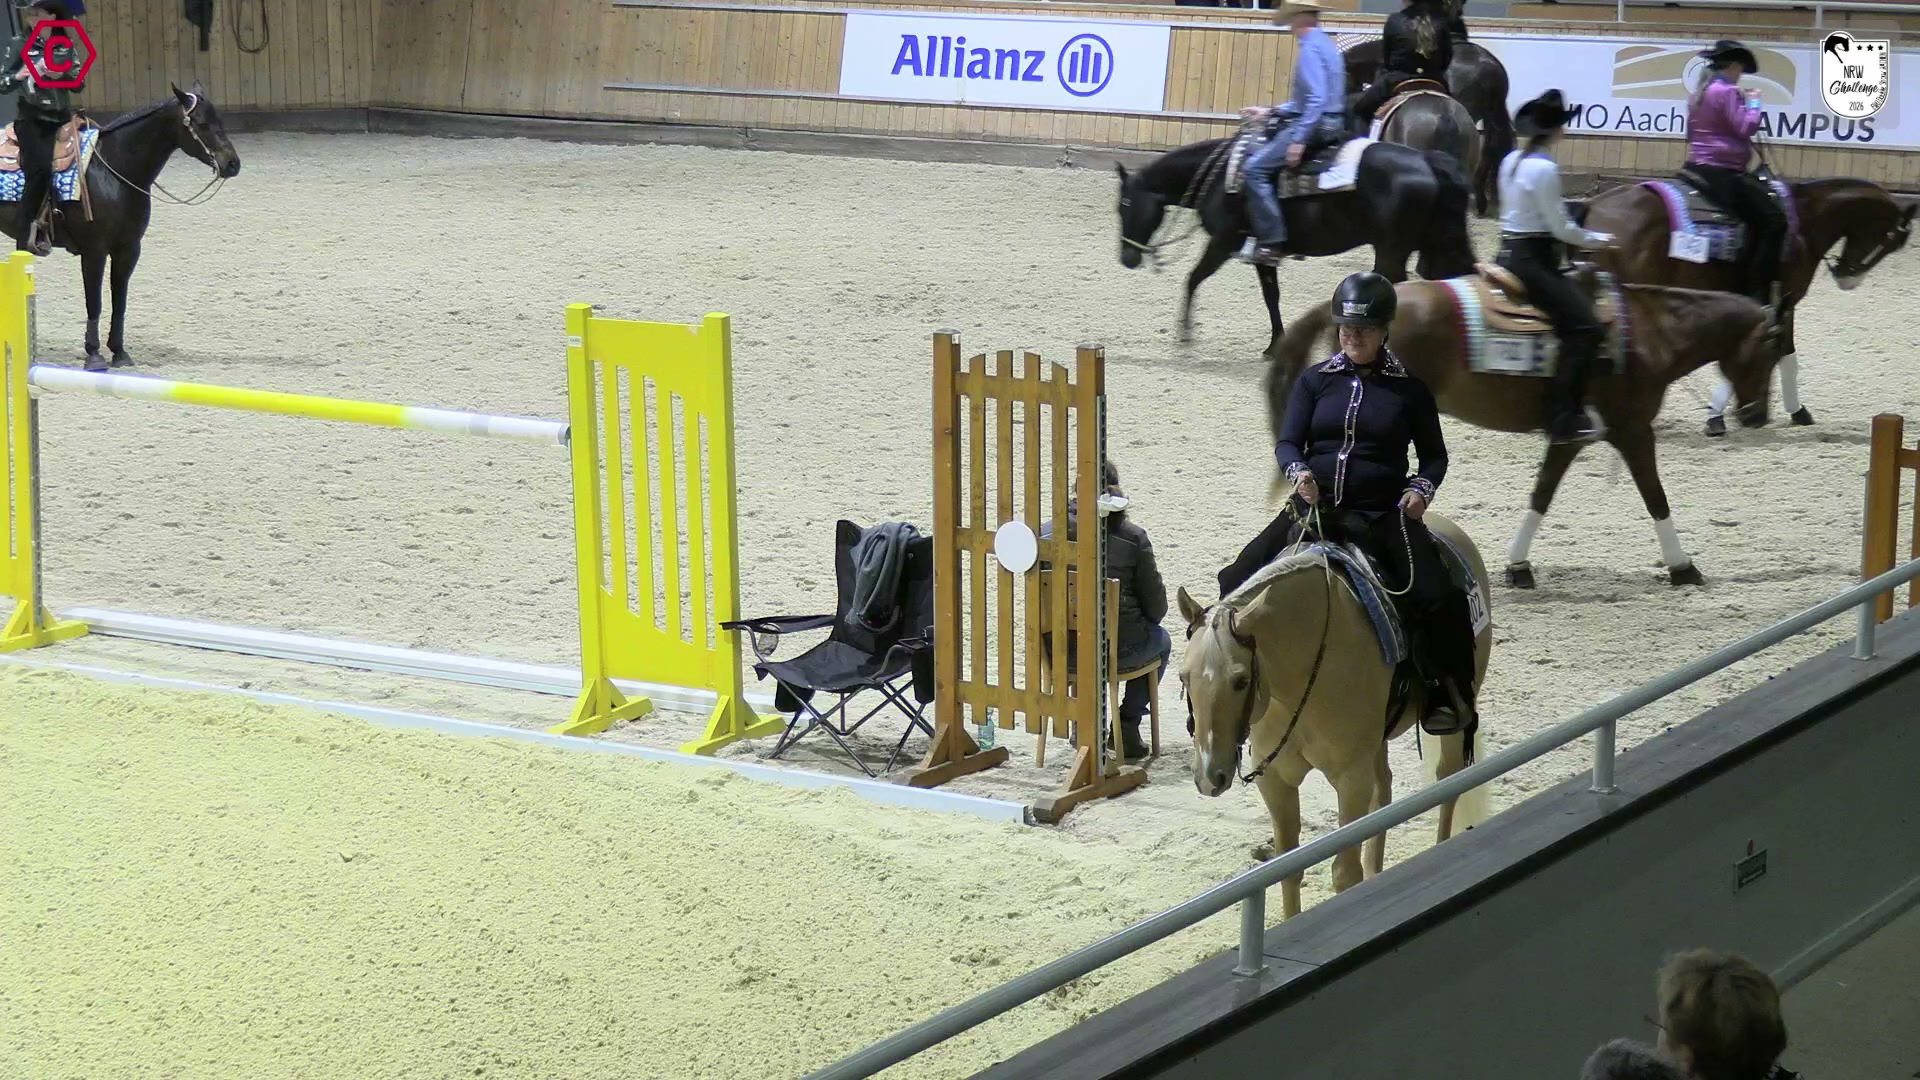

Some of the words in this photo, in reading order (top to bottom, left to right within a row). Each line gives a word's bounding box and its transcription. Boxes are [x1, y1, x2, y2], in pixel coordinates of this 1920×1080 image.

[891, 34, 1046, 82] Allianz
[1614, 105, 1686, 133] Aach
[1757, 111, 1876, 143] AMPUS
